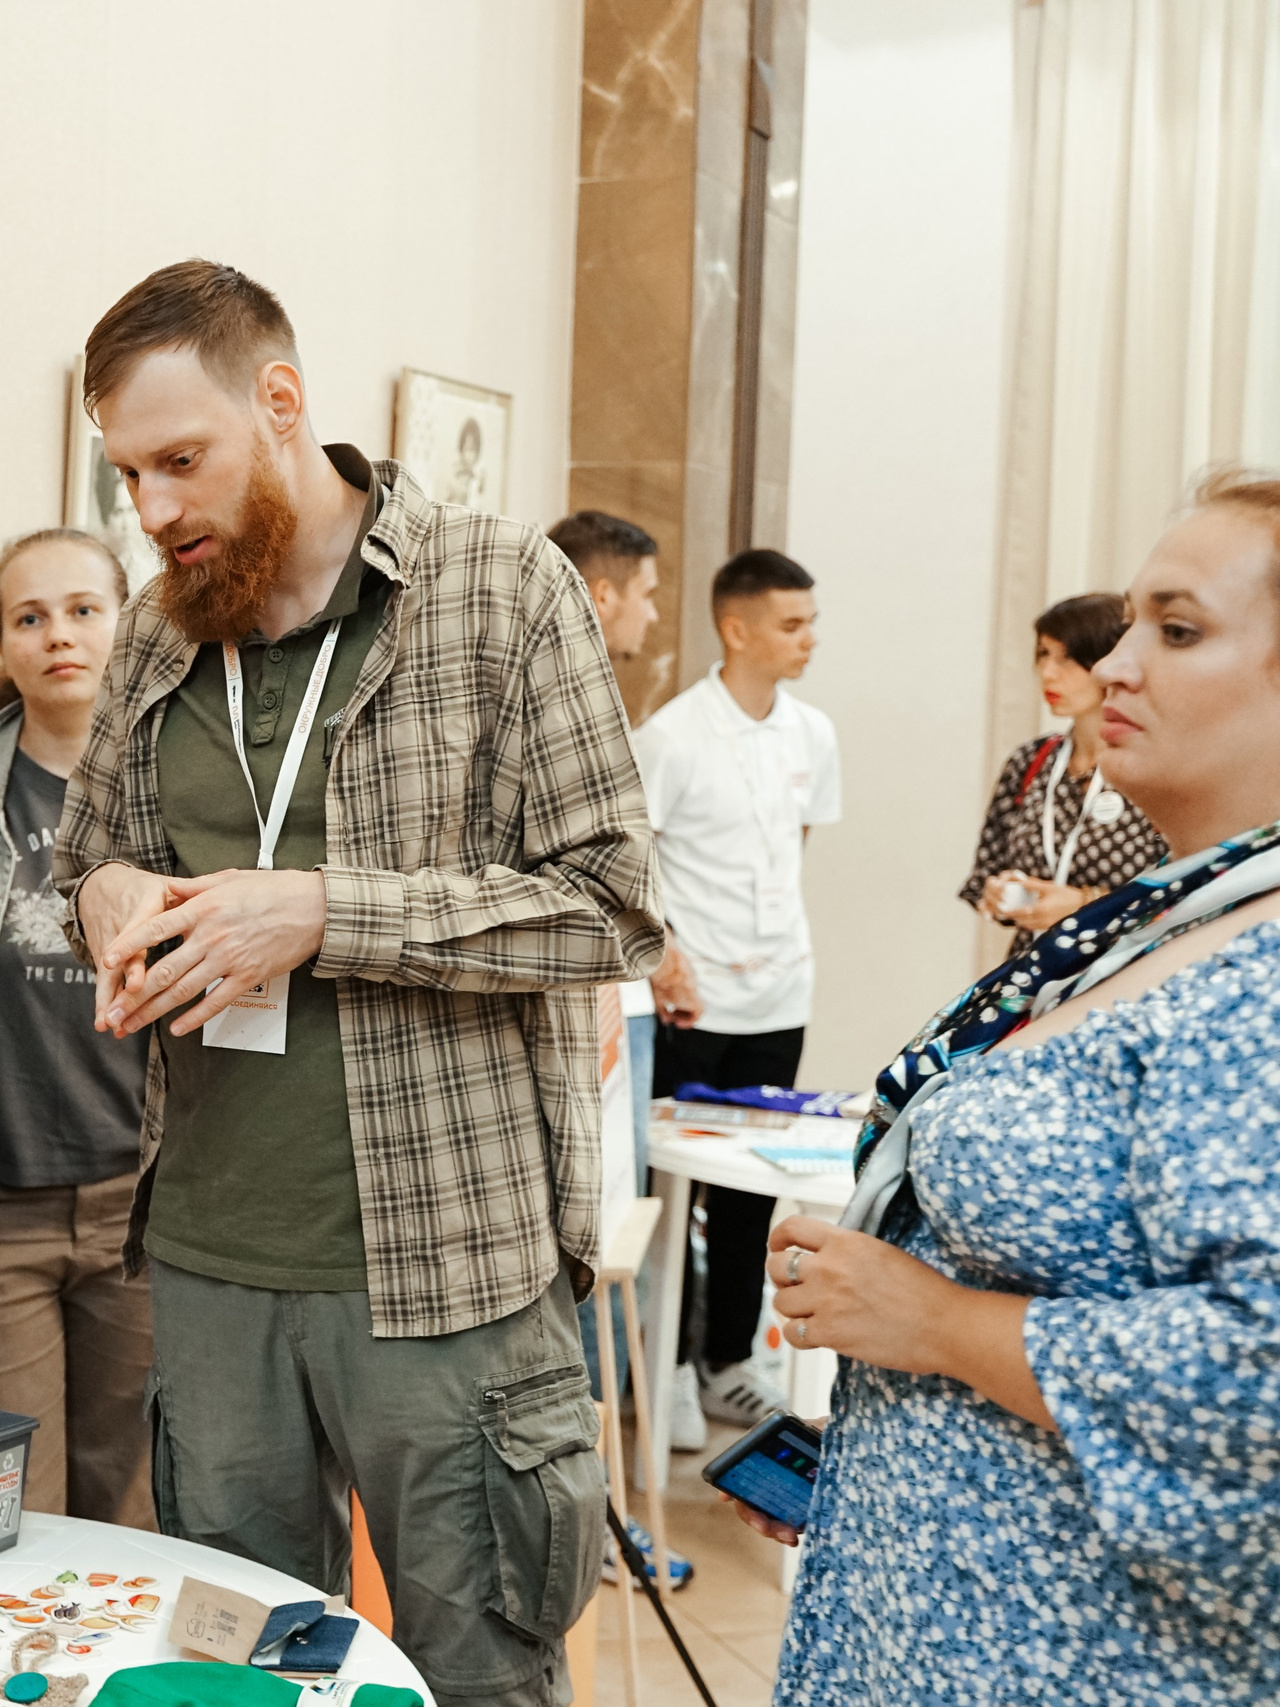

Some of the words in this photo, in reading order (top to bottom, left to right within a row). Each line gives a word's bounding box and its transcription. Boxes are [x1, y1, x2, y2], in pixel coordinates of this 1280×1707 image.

[298, 679, 321, 734] ОКРУЖНЫЕ
[315, 644, 332, 679] ДОБРО
[27, 827, 60, 852] DA
[25, 965, 54, 983] THE
[230, 1000, 279, 1011] СОЕДИНЯЙСЯ
